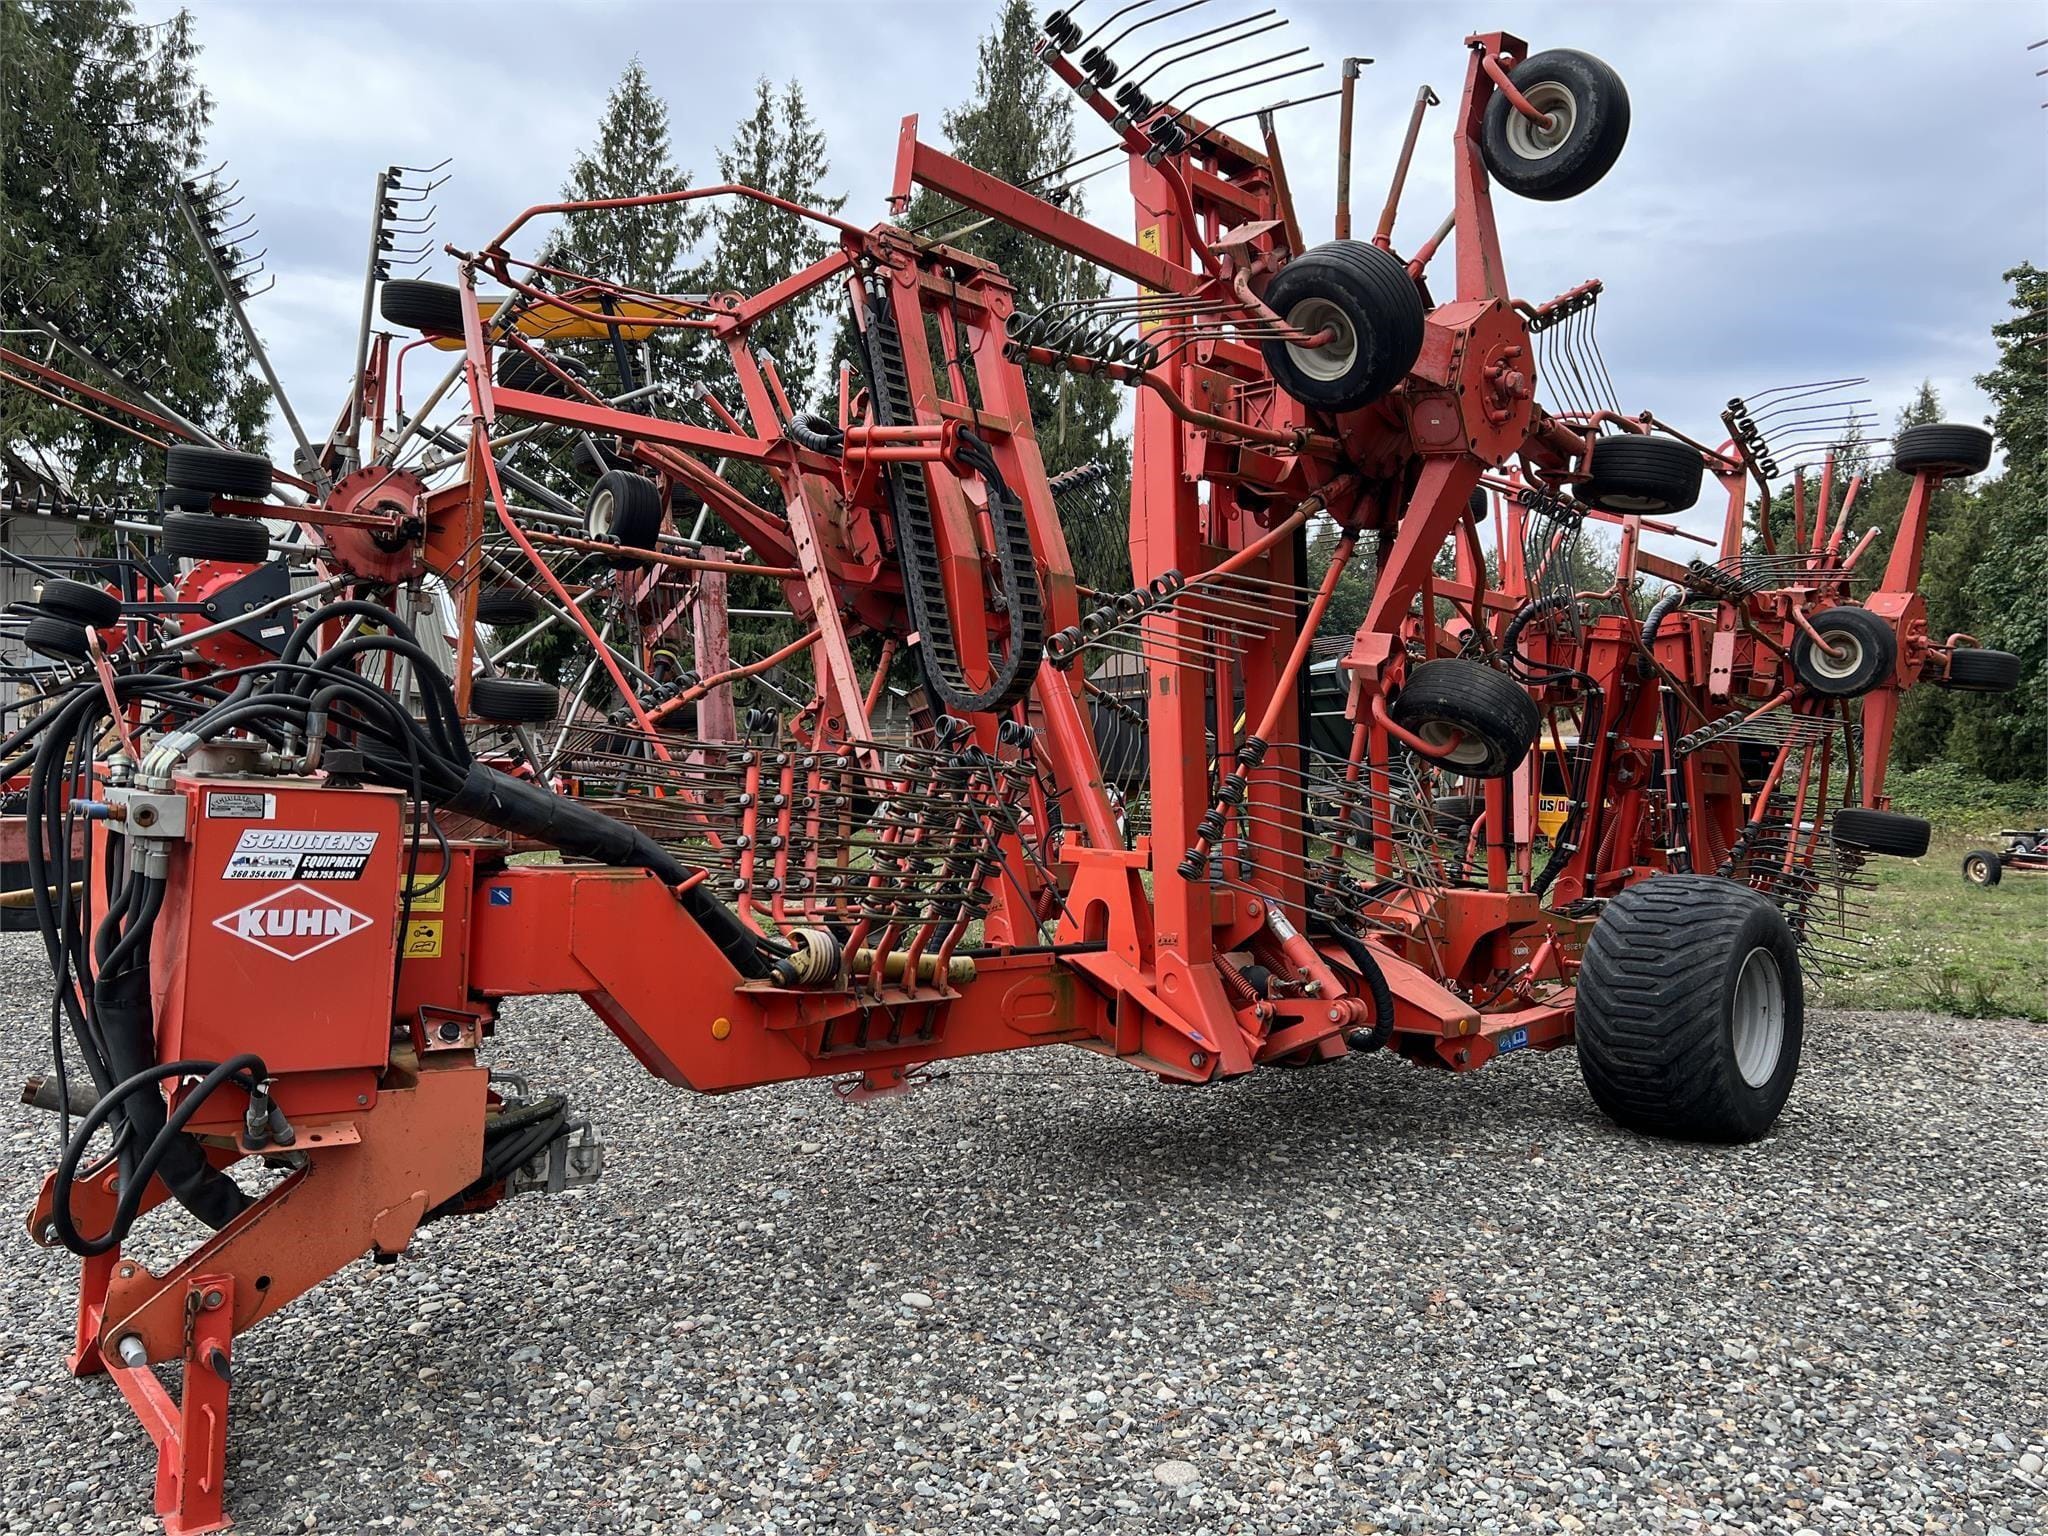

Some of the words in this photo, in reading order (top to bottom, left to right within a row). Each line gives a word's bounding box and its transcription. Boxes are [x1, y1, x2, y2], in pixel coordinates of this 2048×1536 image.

[241, 832, 373, 851] SCHOLTEN'S
[301, 855, 367, 869] EQUIPMENT
[231, 870, 287, 878] 360.354.4071
[237, 908, 352, 937] KUHN
